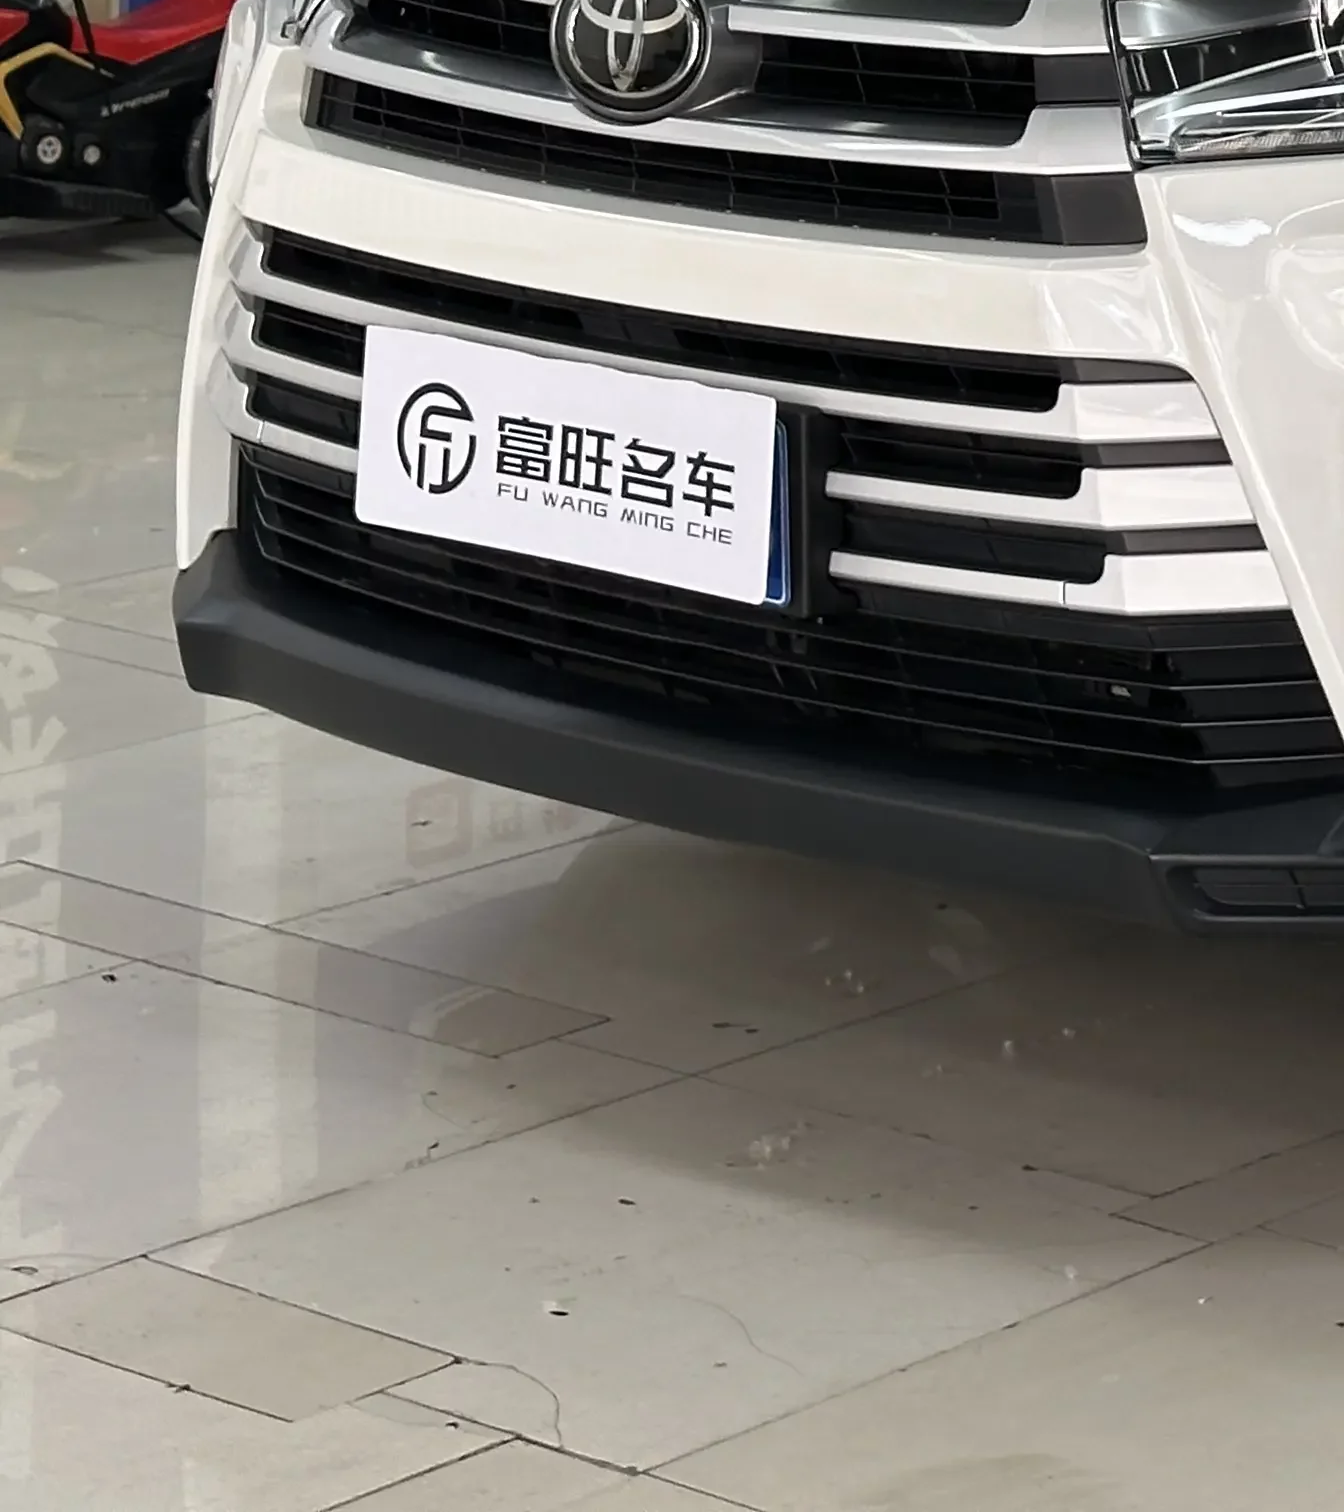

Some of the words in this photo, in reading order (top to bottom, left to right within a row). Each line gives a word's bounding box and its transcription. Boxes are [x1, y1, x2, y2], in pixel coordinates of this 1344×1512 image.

[496, 415, 736, 518] 富旺名车
[496, 483, 529, 502] FU
[542, 491, 608, 518] WANG
[620, 507, 674, 532] MING
[686, 521, 734, 545] CHE
